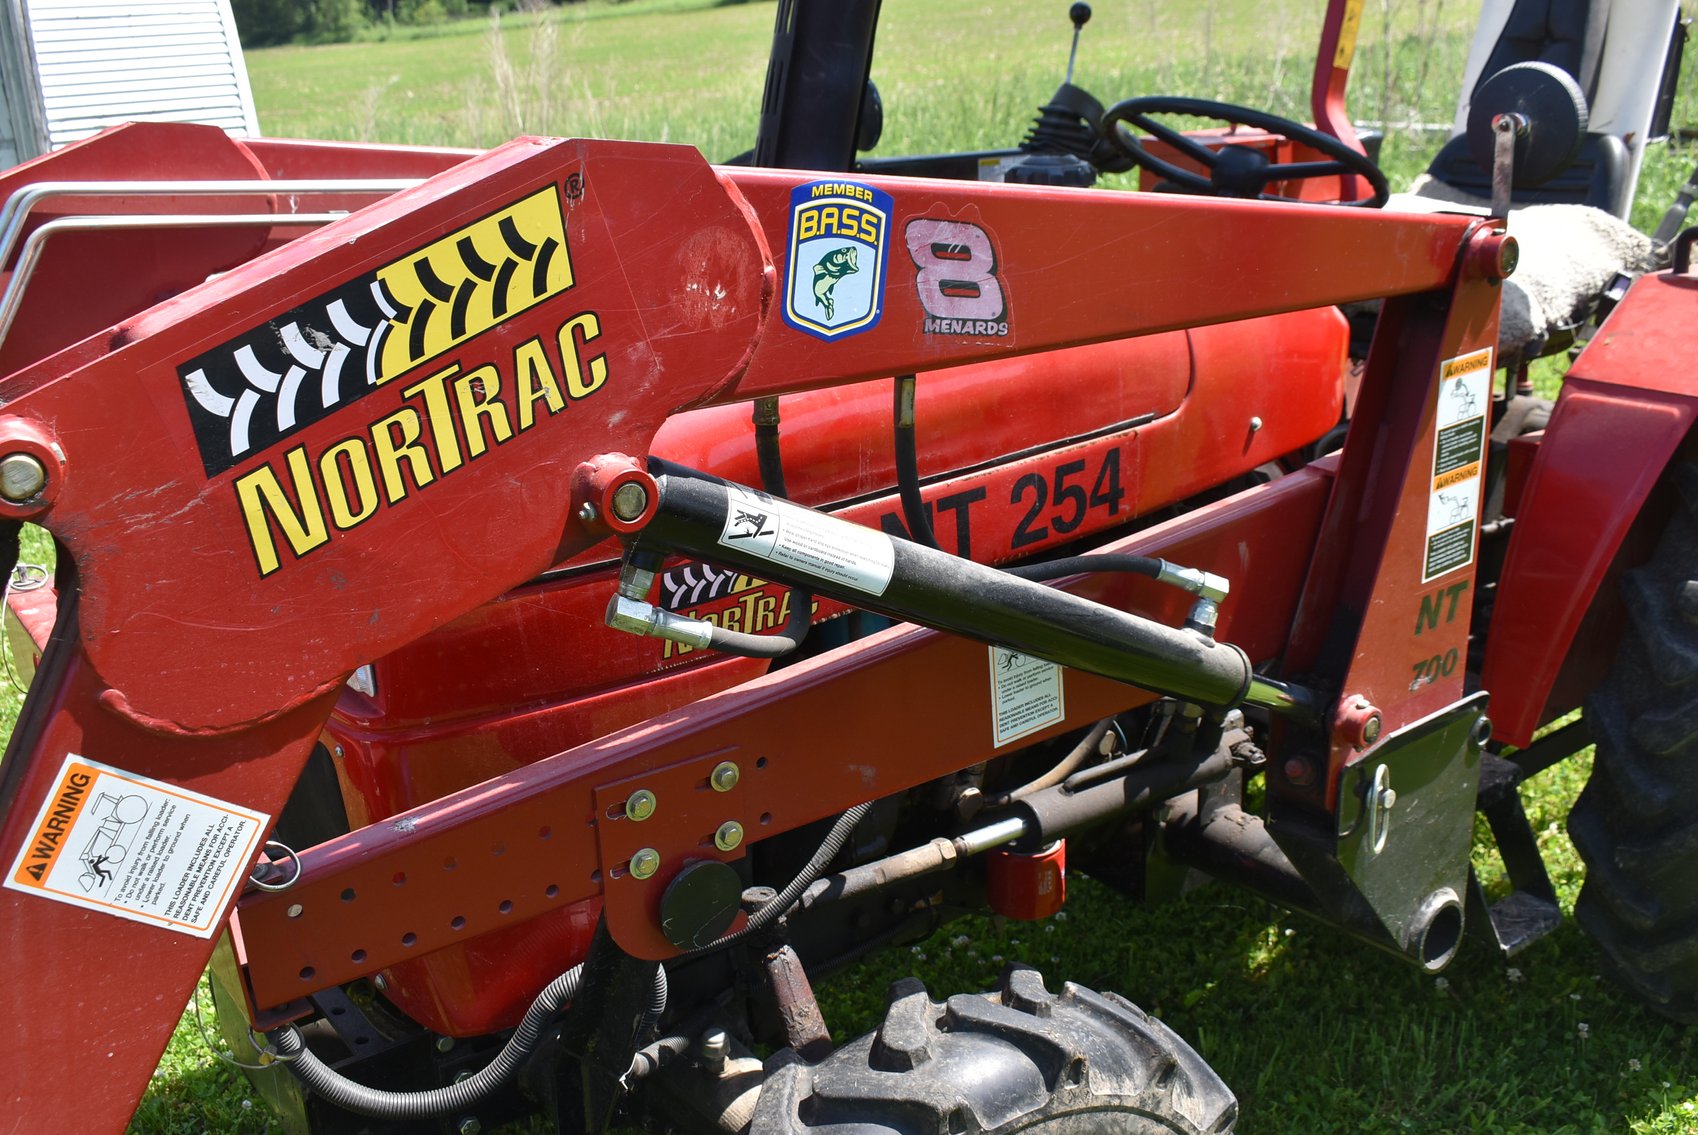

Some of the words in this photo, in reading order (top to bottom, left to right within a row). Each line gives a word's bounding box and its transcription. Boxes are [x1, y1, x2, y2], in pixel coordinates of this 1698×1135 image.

[800, 206, 879, 246] B.A.S.S.
[811, 183, 873, 203] MEMBER
[905, 218, 1007, 320] 8
[923, 318, 1009, 336] MENARDS
[1452, 355, 1488, 375] WARNING
[1009, 447, 1126, 549] 254
[1442, 466, 1478, 490] WARNING
[1415, 581, 1469, 636] NT
[32, 773, 91, 859] WARNING
[126, 889, 134, 898] Do
[132, 877, 140, 888] not
[138, 863, 148, 876] walk
[150, 828, 165, 853] perform
[163, 805, 176, 827] service
[114, 893, 123, 901] To
[121, 875, 132, 892] avoid
[129, 857, 142, 874] injury
[138, 841, 149, 855] from
[145, 821, 160, 840] falling
[136, 883, 146, 900] under
[147, 856, 160, 876] raised
[156, 836, 170, 855] loader.
[143, 883, 155, 903] Lower
[152, 863, 165, 882] loader
[168, 831, 182, 854] ground
[179, 814, 190, 830] when
[152, 883, 166, 905] parked.
[164, 901, 176, 915] THIS
[173, 872, 190, 900] LOADER
[187, 838, 208, 871] INCLUDES
[205, 825, 215, 836] ALL
[173, 874, 199, 918] REASONABLE
[196, 849, 212, 873] MEANS
[209, 834, 219, 848] FOR
[217, 815, 228, 833] ACCI-
[182, 903, 194, 920] DENT
[192, 859, 216, 901] PREVENTION
[213, 832, 229, 858] EXCEPT
[191, 906, 203, 923] SAFE
[201, 891, 210, 905] AND
[208, 860, 227, 889] CAREFUL
[224, 821, 246, 857] OPERATOR.
